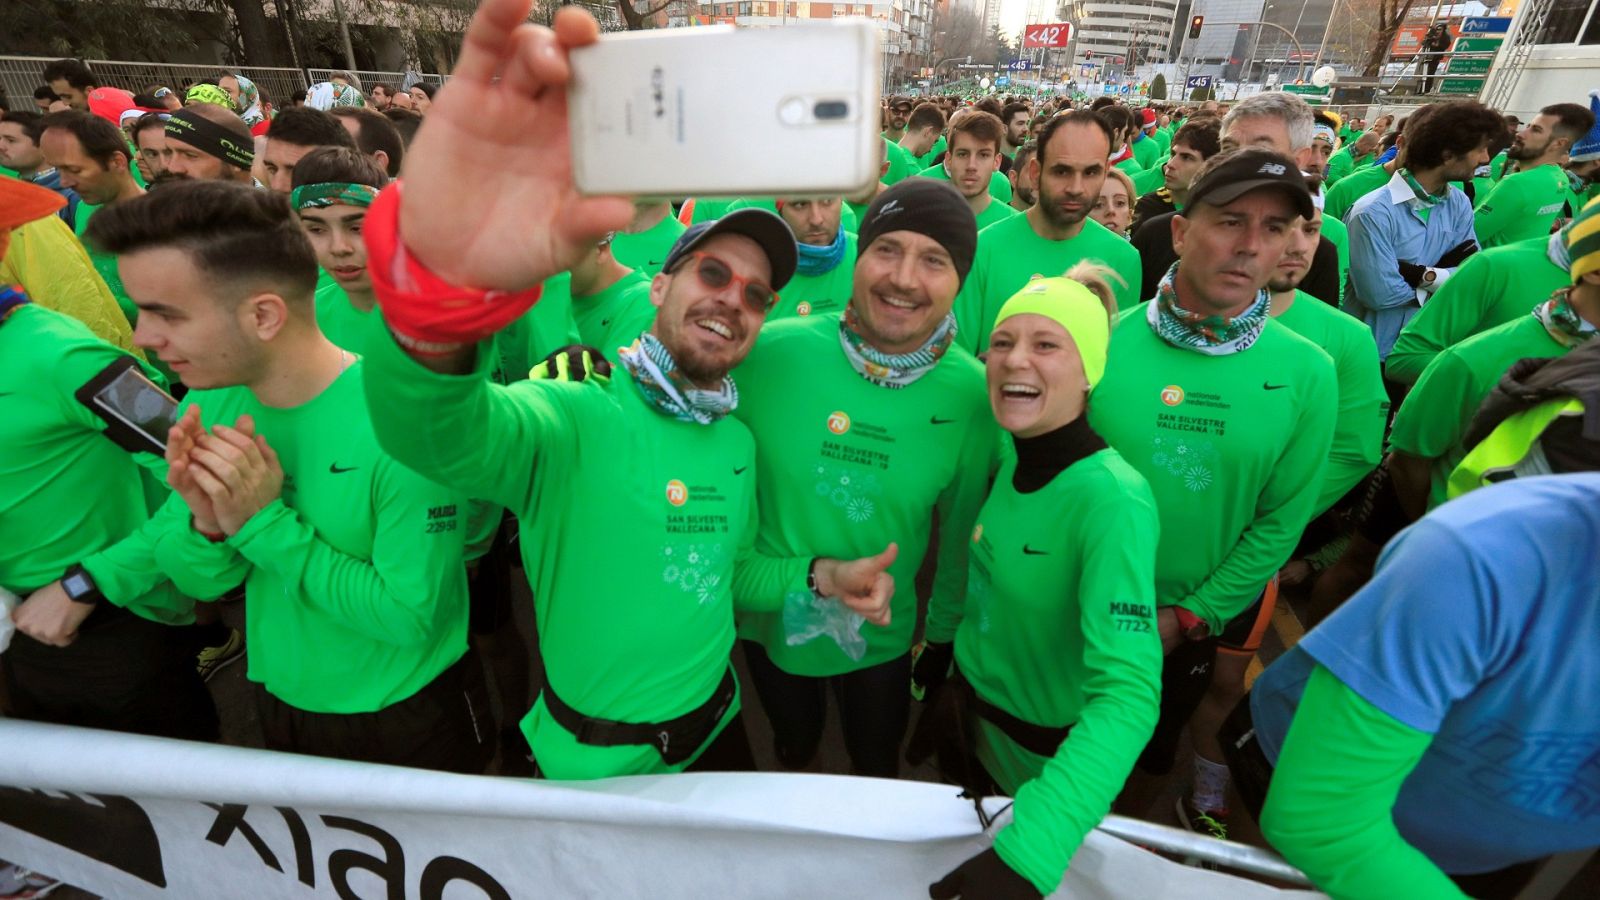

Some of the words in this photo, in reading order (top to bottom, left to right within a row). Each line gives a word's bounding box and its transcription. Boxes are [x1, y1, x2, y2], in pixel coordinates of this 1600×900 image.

[1156, 421, 1208, 434] VALLECANA
[1158, 413, 1176, 422] SAN
[1178, 415, 1226, 429] SILVESTRE
[820, 448, 872, 466] VALLECANA
[822, 440, 840, 451] SAN
[842, 444, 890, 461] SILVESTRE
[666, 514, 685, 523] SAN
[687, 515, 728, 524] SILVESTRE
[1109, 602, 1153, 619] MARCA
